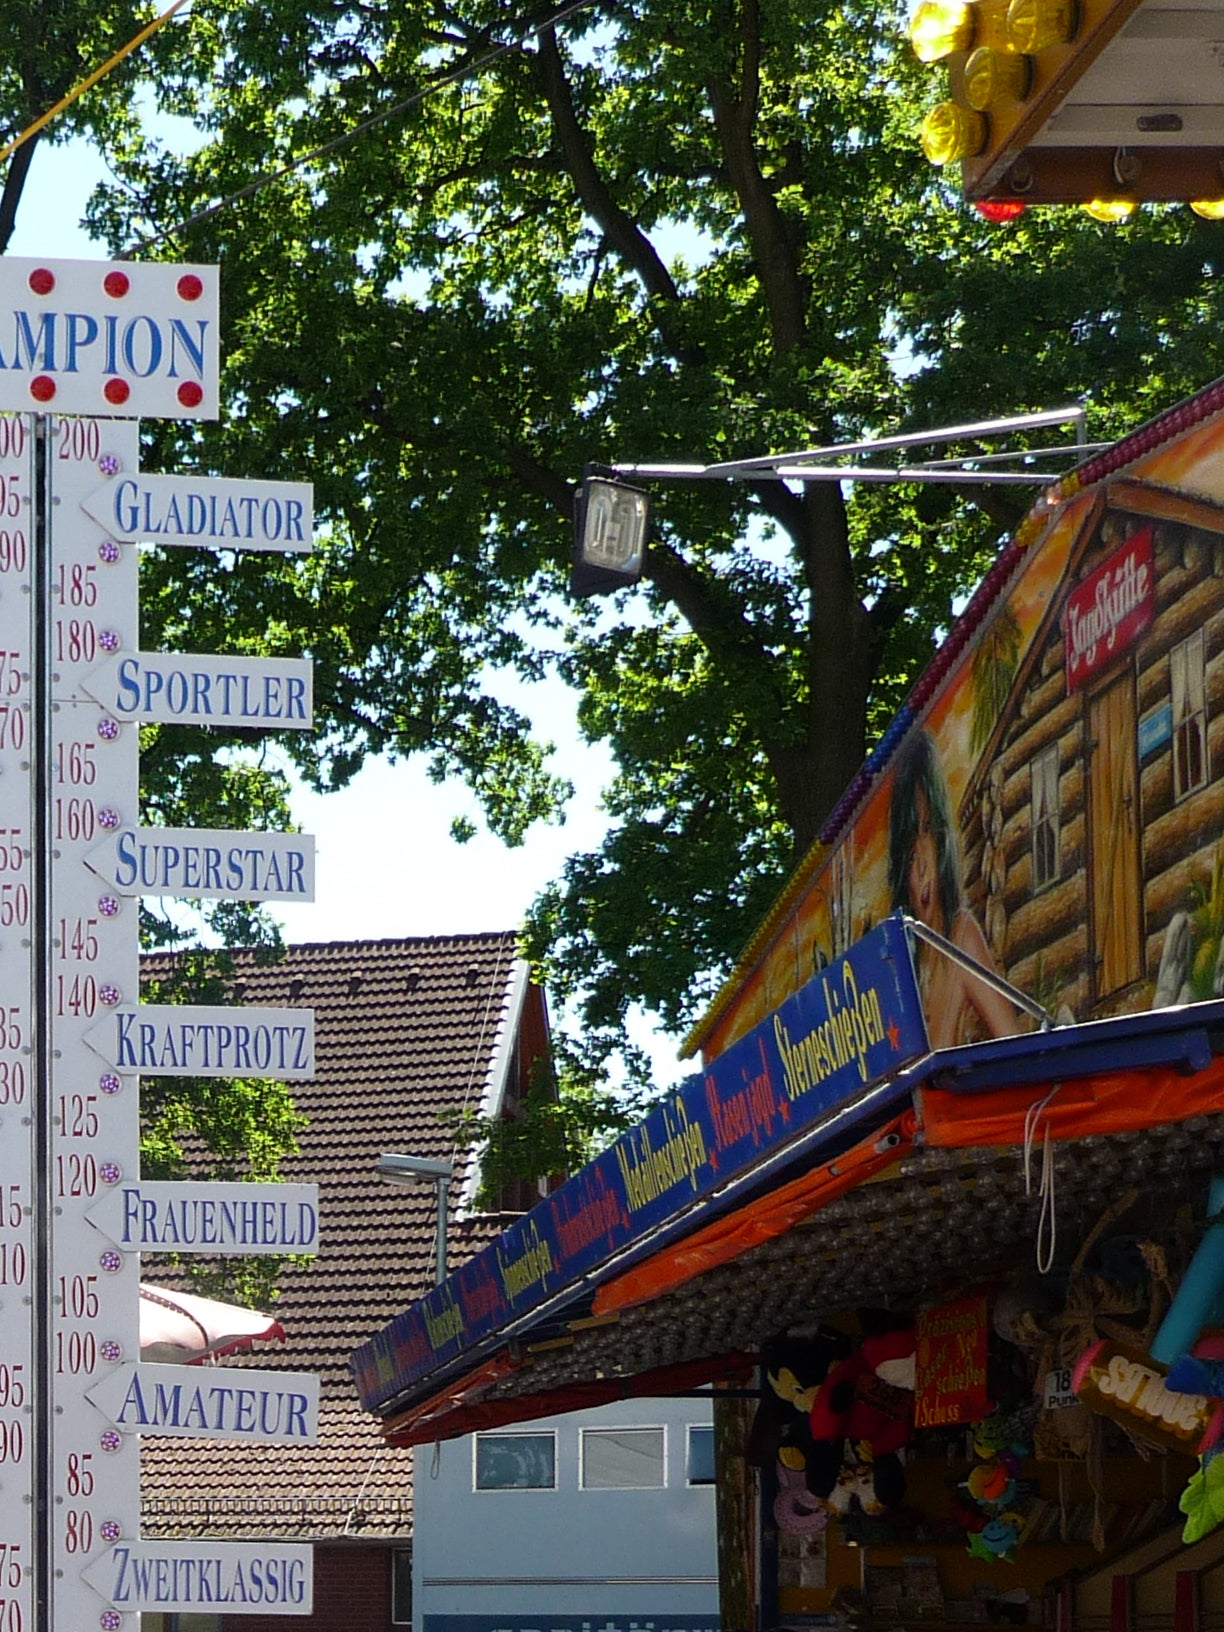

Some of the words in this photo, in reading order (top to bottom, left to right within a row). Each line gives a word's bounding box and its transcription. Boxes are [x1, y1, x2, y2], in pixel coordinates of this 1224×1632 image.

[59, 421, 100, 460] 200
[115, 481, 303, 541] GLADIATOR
[60, 564, 96, 605] 185
[57, 621, 95, 660] 180
[117, 659, 306, 719] SPORTLER
[58, 742, 95, 784] 165
[56, 799, 94, 838] 160
[116, 832, 305, 892] SUPERSTAR
[61, 919, 98, 960] 145
[58, 975, 96, 1017] 140
[116, 1014, 307, 1069] KRAFTPROTZ
[60, 1094, 98, 1137] 125
[57, 1154, 96, 1196] 120
[122, 1189, 315, 1245] FRAUENHELD
[60, 1276, 98, 1318] 105
[57, 1332, 95, 1373] 100
[118, 1373, 308, 1436] AMATEUR
[68, 1453, 93, 1496] 85
[66, 1511, 92, 1552] 80
[114, 1548, 304, 1602] ZWEITKLASSIG
